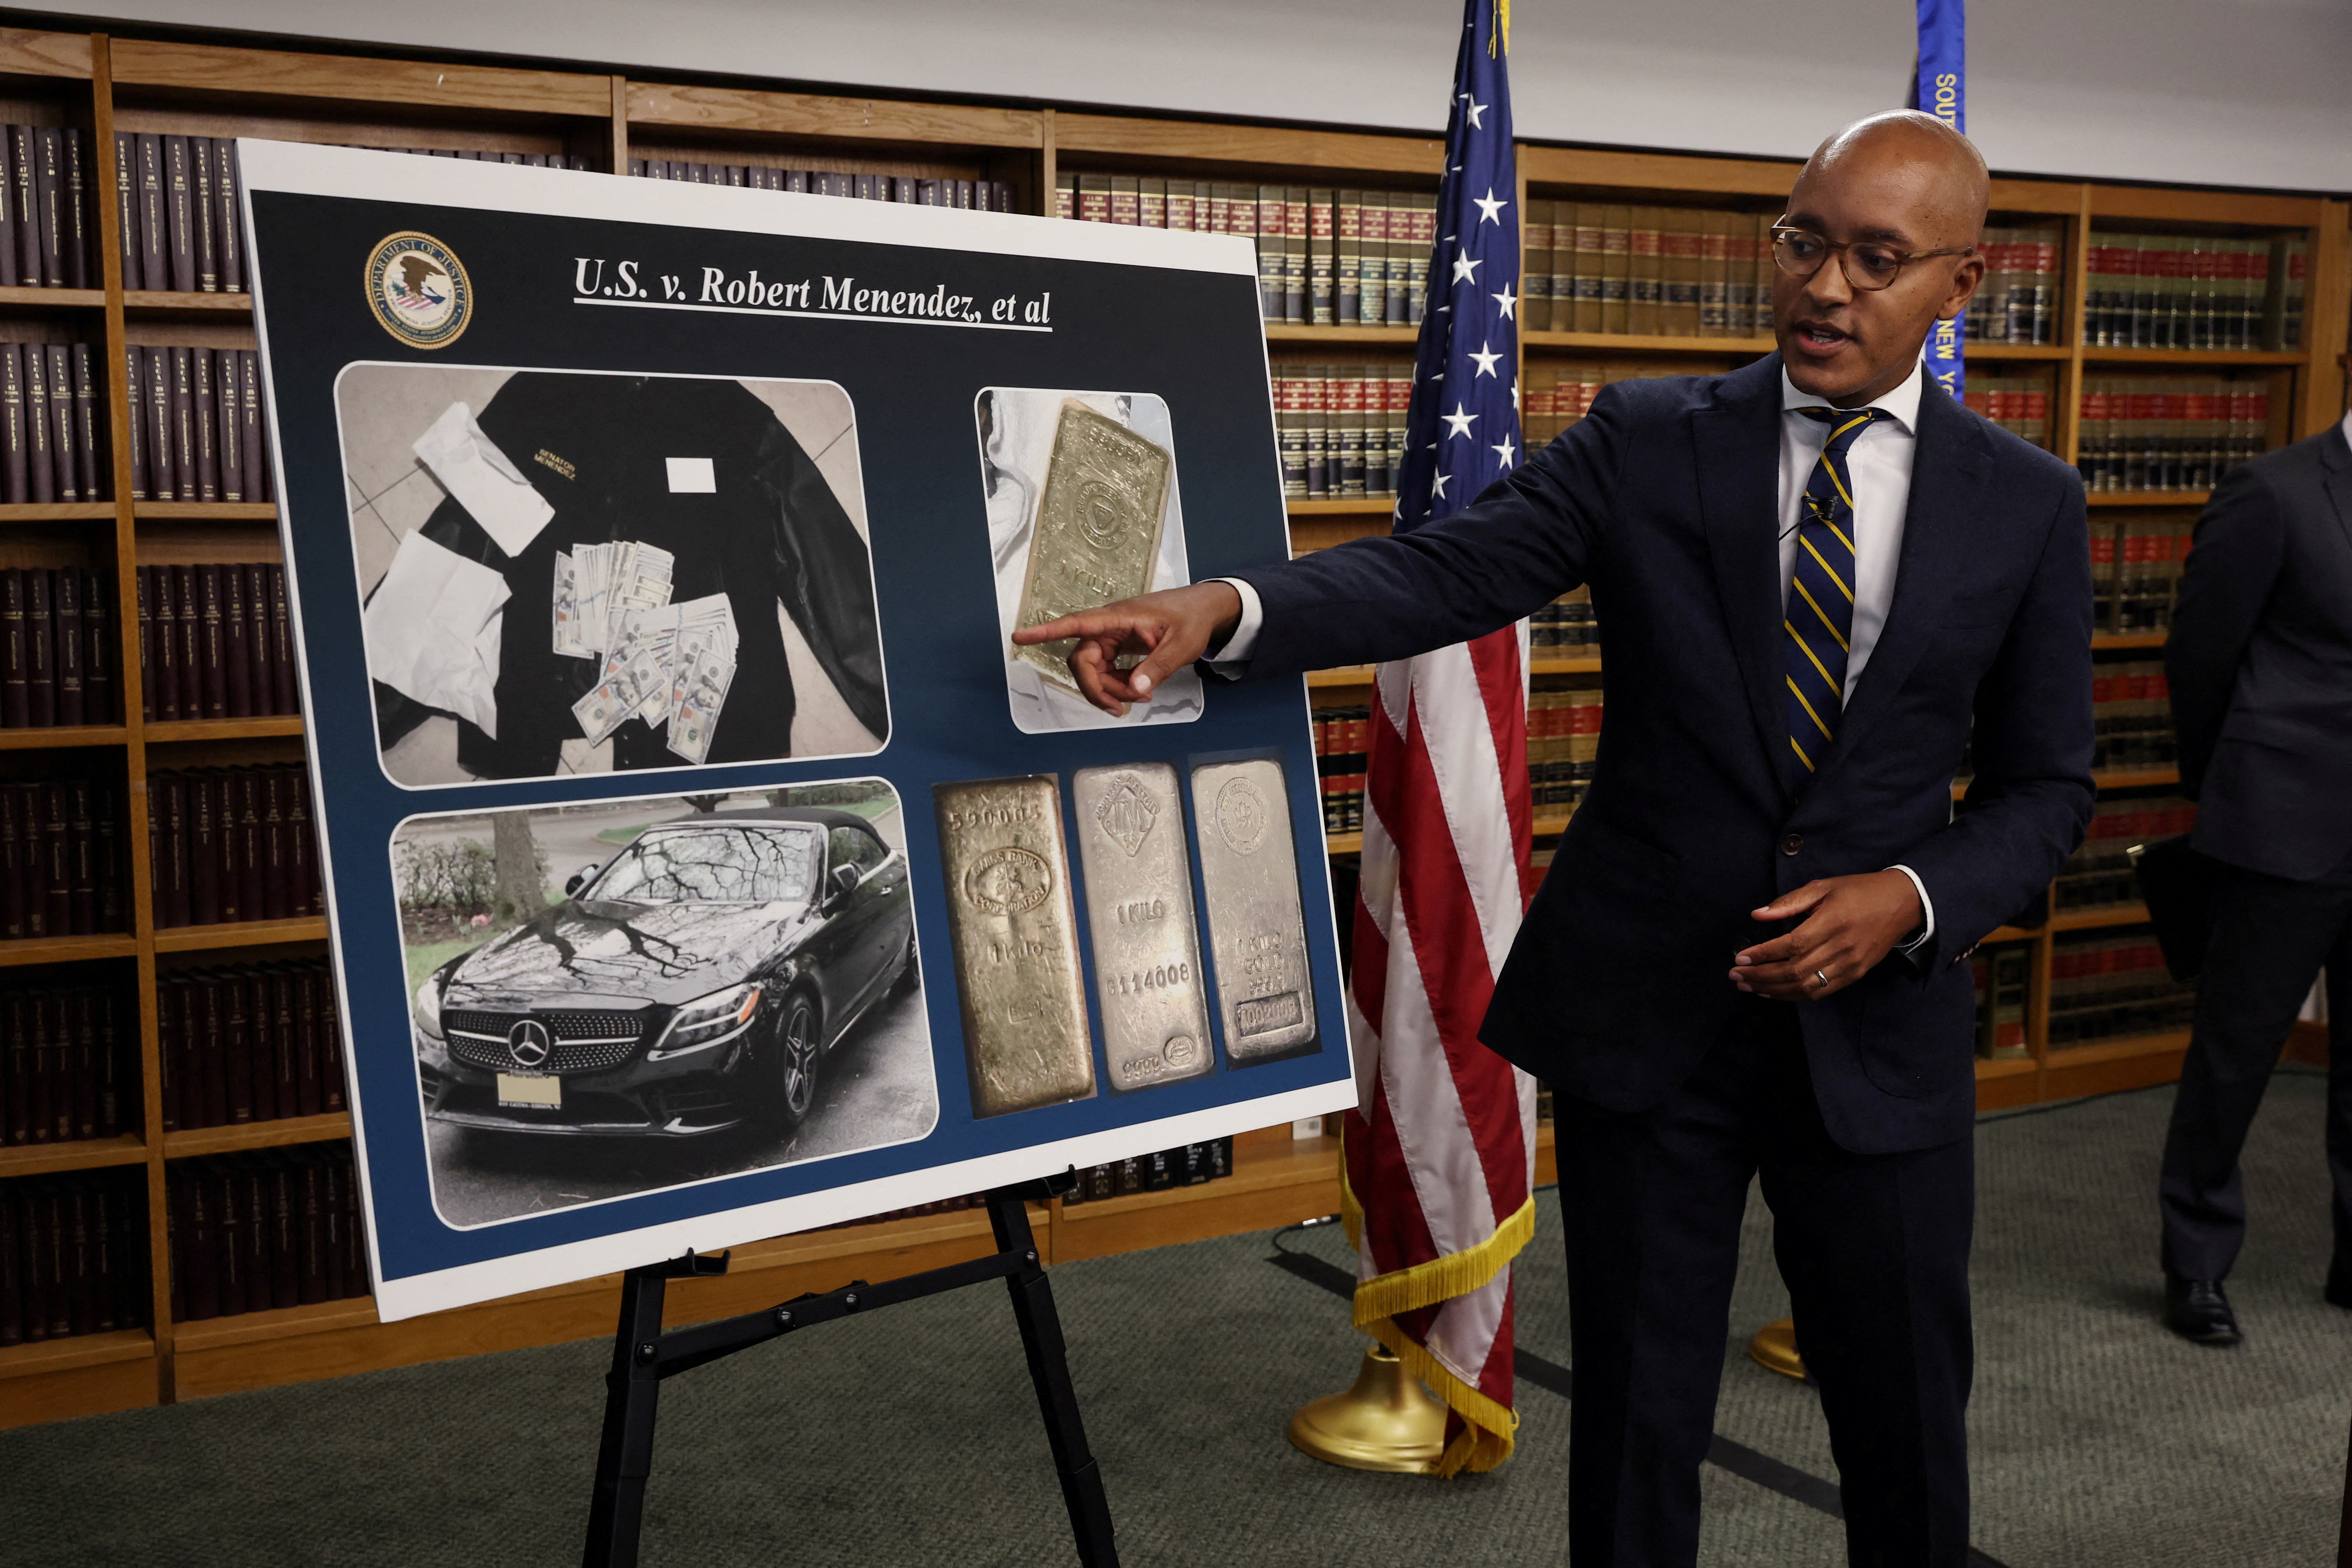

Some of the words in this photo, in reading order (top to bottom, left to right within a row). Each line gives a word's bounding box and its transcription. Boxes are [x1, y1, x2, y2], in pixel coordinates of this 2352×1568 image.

[373, 240, 416, 302] DEPARTMENT
[421, 243, 437, 255] OF
[438, 254, 465, 305] JUSTICE
[575, 258, 647, 298] U.S.
[660, 276, 685, 300] v.
[699, 267, 810, 308] Robert
[819, 277, 981, 323] Menendez,
[992, 295, 1016, 321] et
[1025, 293, 1050, 323] al
[1936, 320, 1956, 359] NEW
[970, 852, 1005, 875] SWISS
[1008, 851, 1038, 872] BANK
[973, 886, 1045, 914] CORPORATION
[1117, 905, 1124, 924] 1
[1129, 900, 1163, 922] KILO
[1239, 939, 1244, 955] 1
[1249, 932, 1283, 953] KILO
[1244, 952, 1284, 975] GOLD
[1249, 973, 1285, 995] 999.9
